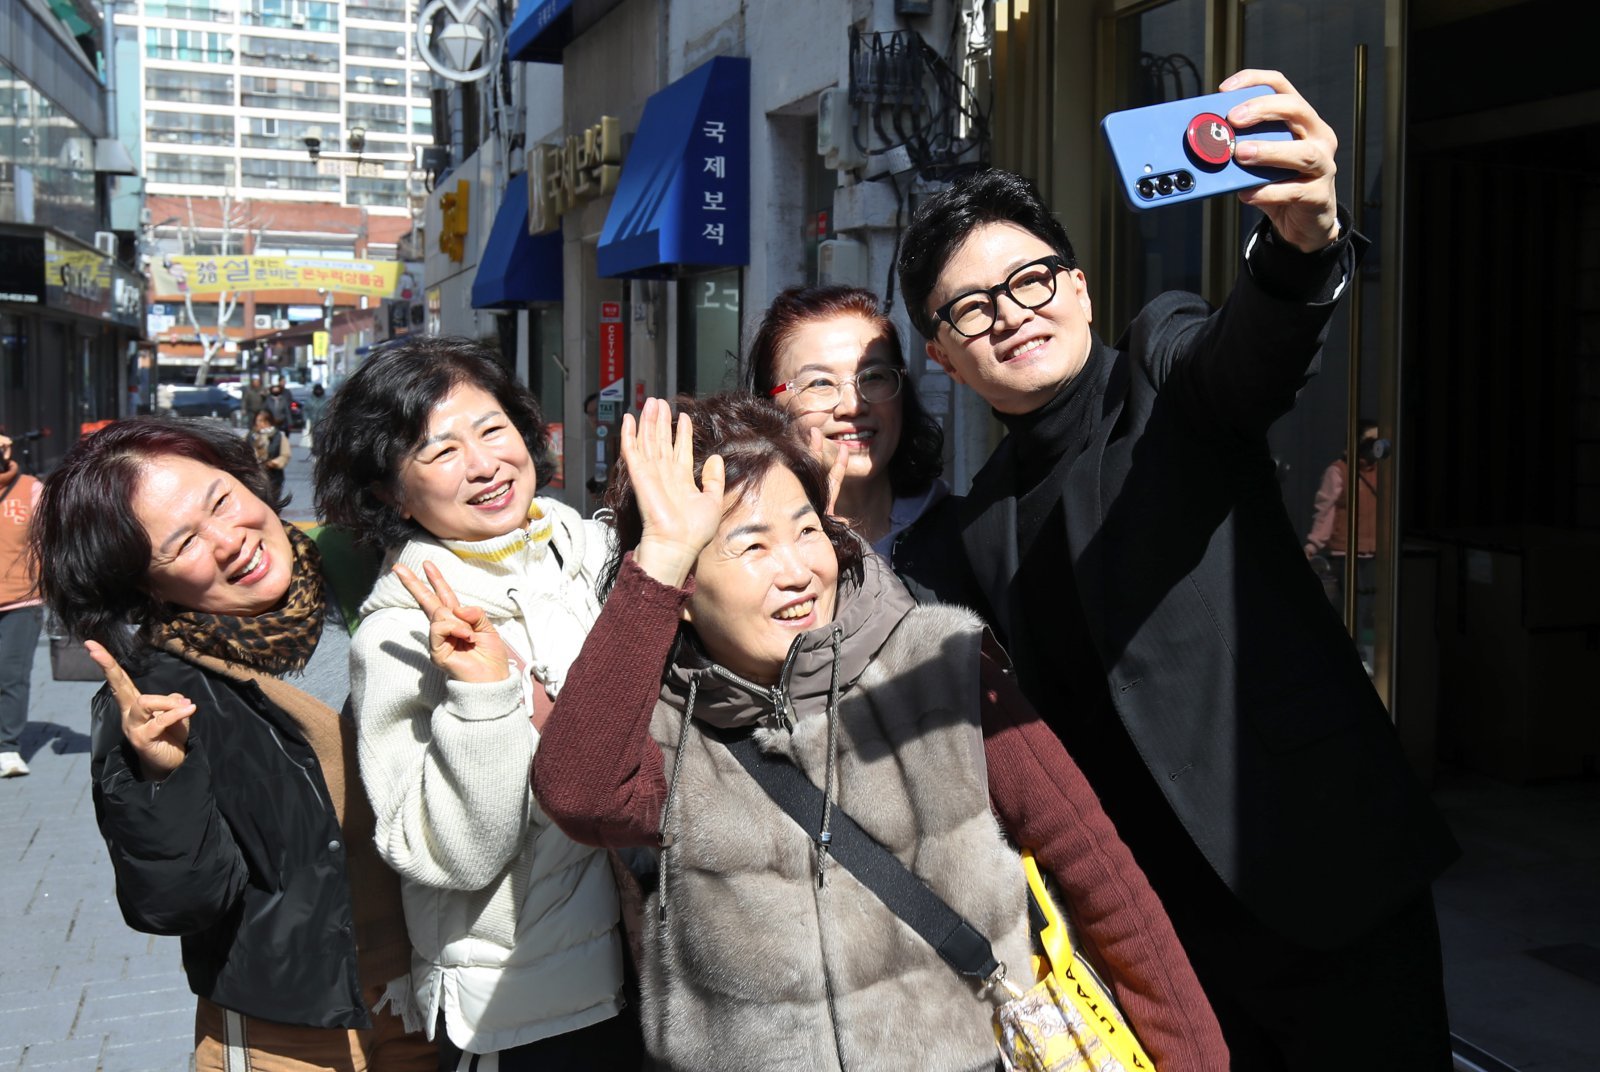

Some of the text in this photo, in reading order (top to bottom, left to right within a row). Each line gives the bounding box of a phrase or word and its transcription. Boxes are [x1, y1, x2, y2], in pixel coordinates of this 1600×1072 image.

[546, 115, 620, 212] 국제보석
[702, 120, 727, 246] 국제보석
[1065, 962, 1116, 1035] UTAA
